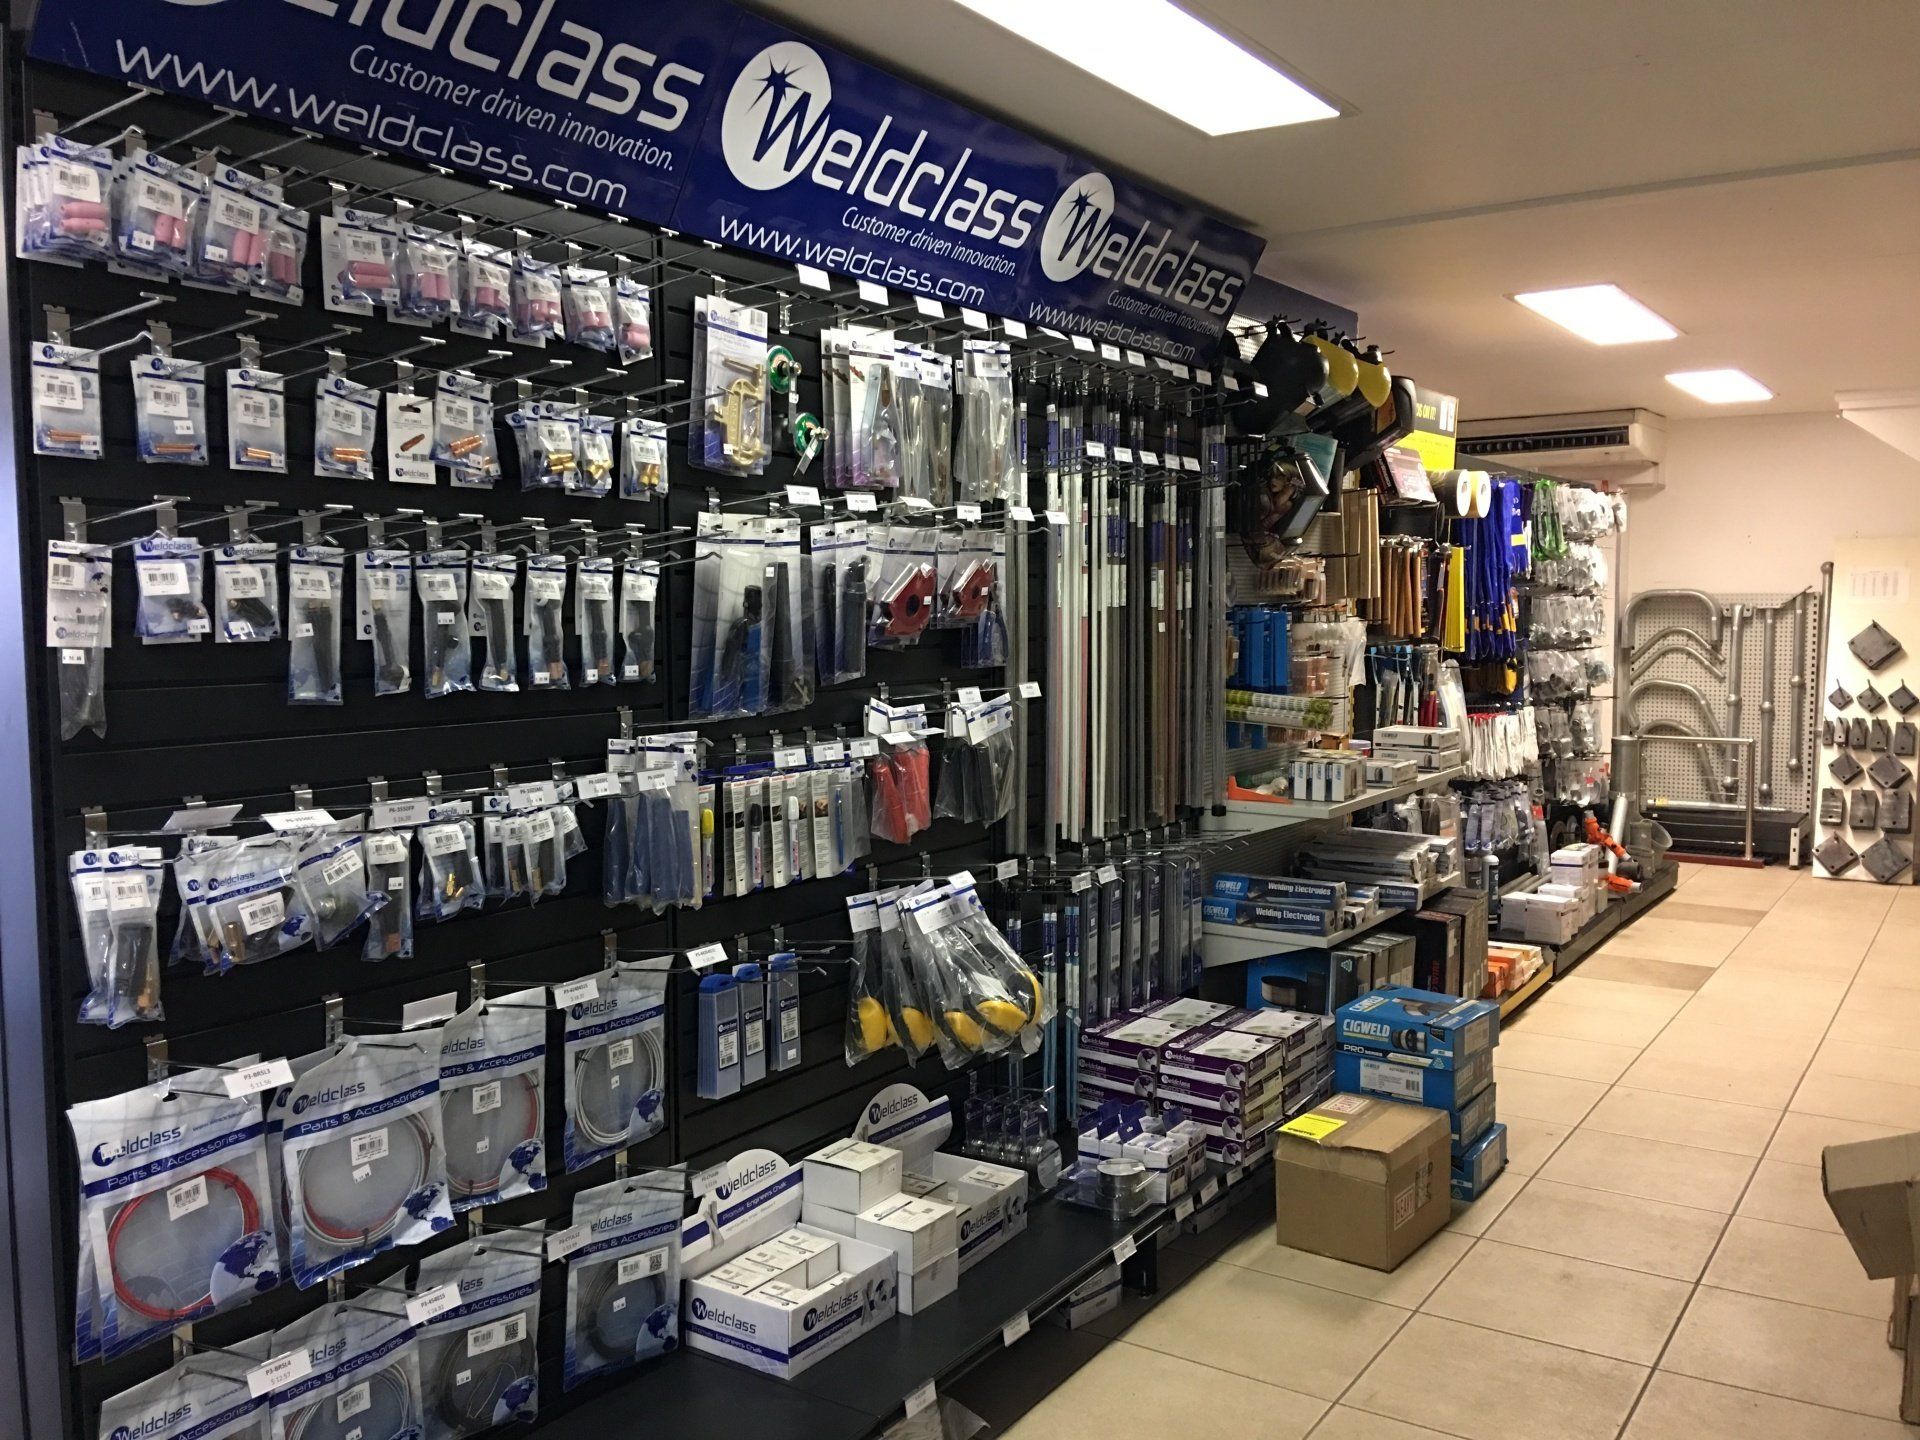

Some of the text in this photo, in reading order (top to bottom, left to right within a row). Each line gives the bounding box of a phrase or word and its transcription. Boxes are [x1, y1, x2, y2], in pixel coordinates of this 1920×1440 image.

[116, 39, 628, 208] www.weldclass.com
[349, 44, 674, 171] Customer driven innovation.
[728, 45, 1044, 249] Weldclass
[842, 206, 1016, 277] Customer driven innovation.
[1043, 174, 1243, 314] Weldclass
[720, 215, 985, 306] www.weldclass.com
[1107, 289, 1152, 316] Customer
[1150, 302, 1179, 324] driven
[1029, 302, 1196, 361] www.weldclass.com
[141, 540, 193, 553] Weldclass
[208, 871, 255, 890] Weldclass
[1215, 880, 1241, 890] CIGWELD
[1268, 881, 1331, 895] Welding Electrodes
[1203, 905, 1229, 915] CIGWELD
[1256, 907, 1320, 922] Welding Electrodes
[610, 1010, 657, 1028] Accessories
[1349, 995, 1384, 1012] CIGWELD
[1343, 1018, 1390, 1038] CIGWELD
[467, 1063, 475, 1072] &
[478, 1050, 534, 1070] Accessories
[1343, 1044, 1364, 1053] PRO
[292, 1081, 366, 1114] Weldclass
[301, 1087, 424, 1134] Parts & Accessories
[869, 1092, 918, 1125] Weldclass
[92, 1126, 182, 1167] eldclass
[107, 1131, 246, 1190] Parts & Accessories
[716, 1158, 777, 1200] Weldclass
[746, 1190, 773, 1208] Engineers
[772, 1181, 787, 1193] Chalk
[591, 1211, 633, 1232] eldclass
[961, 1204, 1001, 1241] Weldclass
[583, 1240, 606, 1255] Parts
[610, 1238, 618, 1248] &
[620, 1223, 675, 1245] Accessories
[458, 1306, 468, 1318] &
[470, 1286, 532, 1311] Accessories
[692, 1297, 757, 1335] Weldclass
[803, 1290, 858, 1331] Weldclass
[287, 1337, 403, 1400] Parts & Accessories
[111, 1403, 192, 1440] Weldclass
